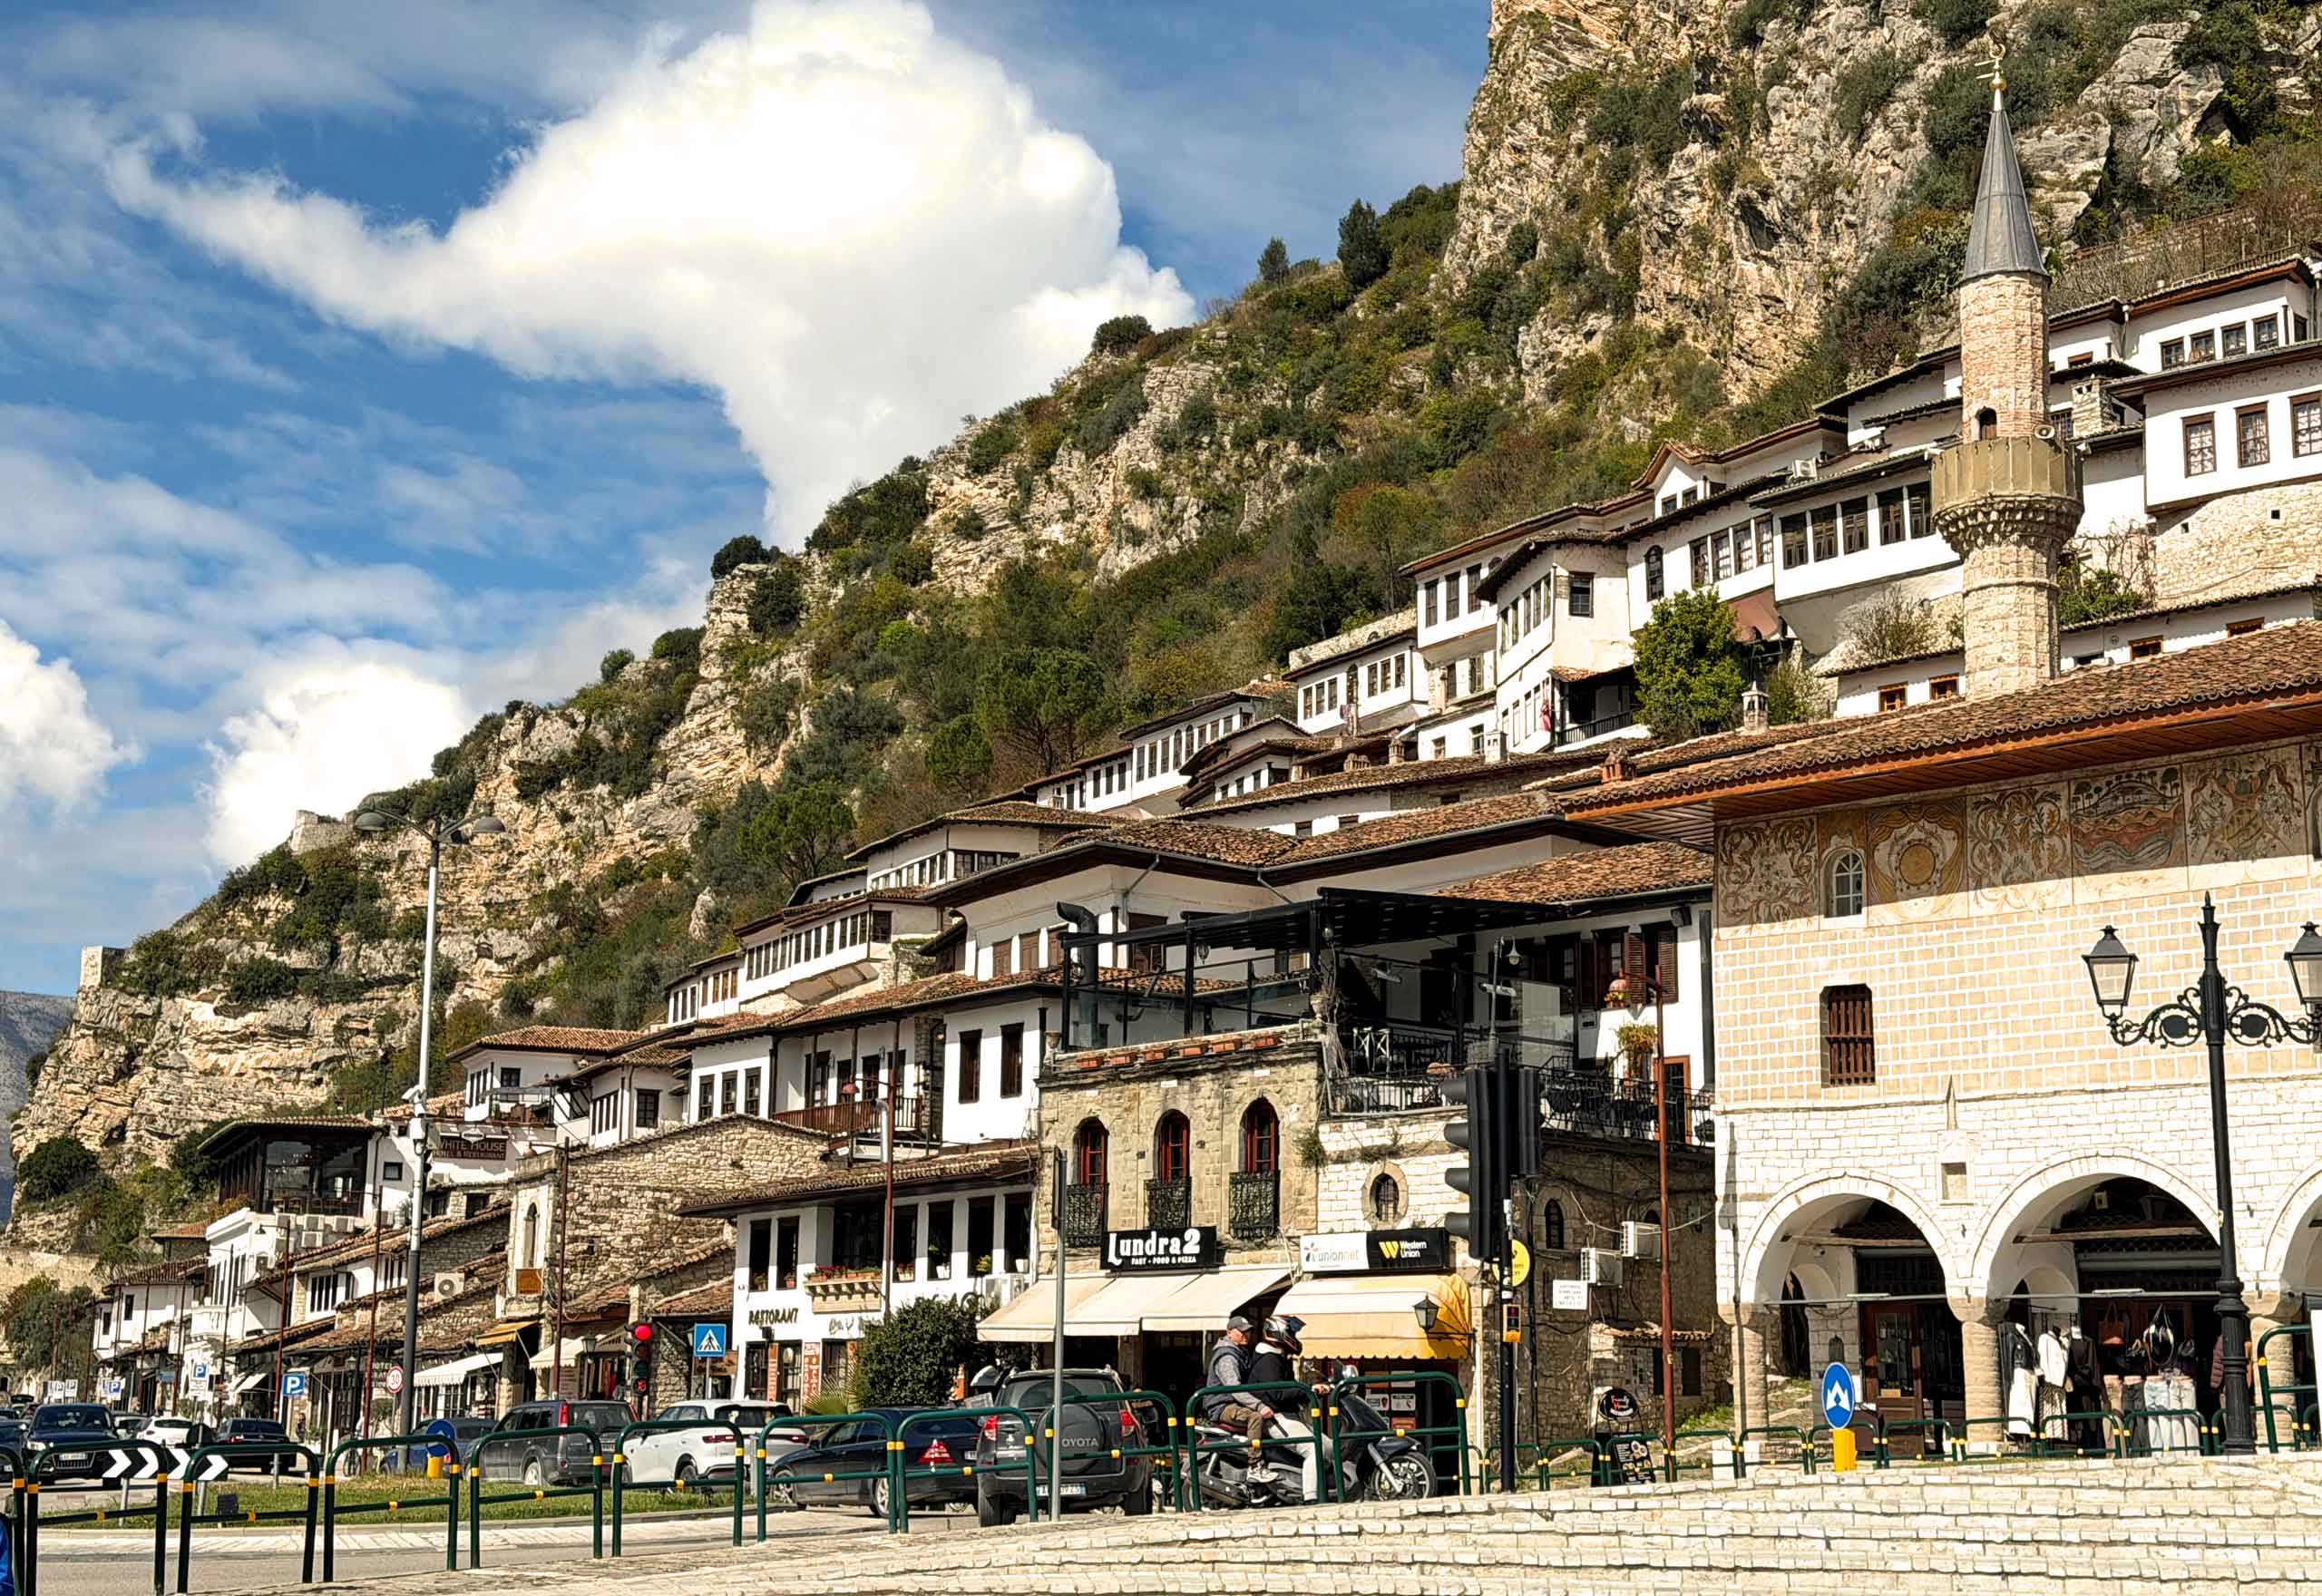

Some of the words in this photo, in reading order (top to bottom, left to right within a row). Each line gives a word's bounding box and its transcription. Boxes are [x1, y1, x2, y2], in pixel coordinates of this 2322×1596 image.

[471, 1142, 505, 1152] HOUSE
[1400, 1241, 1427, 1250] Western
[1400, 1249, 1420, 1259] Union
[1131, 1257, 1146, 1265] FAST
[1153, 1256, 1170, 1264] FOOD
[1177, 1255, 1196, 1263] PIZZA
[195, 1366, 204, 1377] P
[391, 1373, 400, 1386] 30
[287, 1377, 300, 1393] P
[1061, 1437, 1098, 1448] OYOTA
